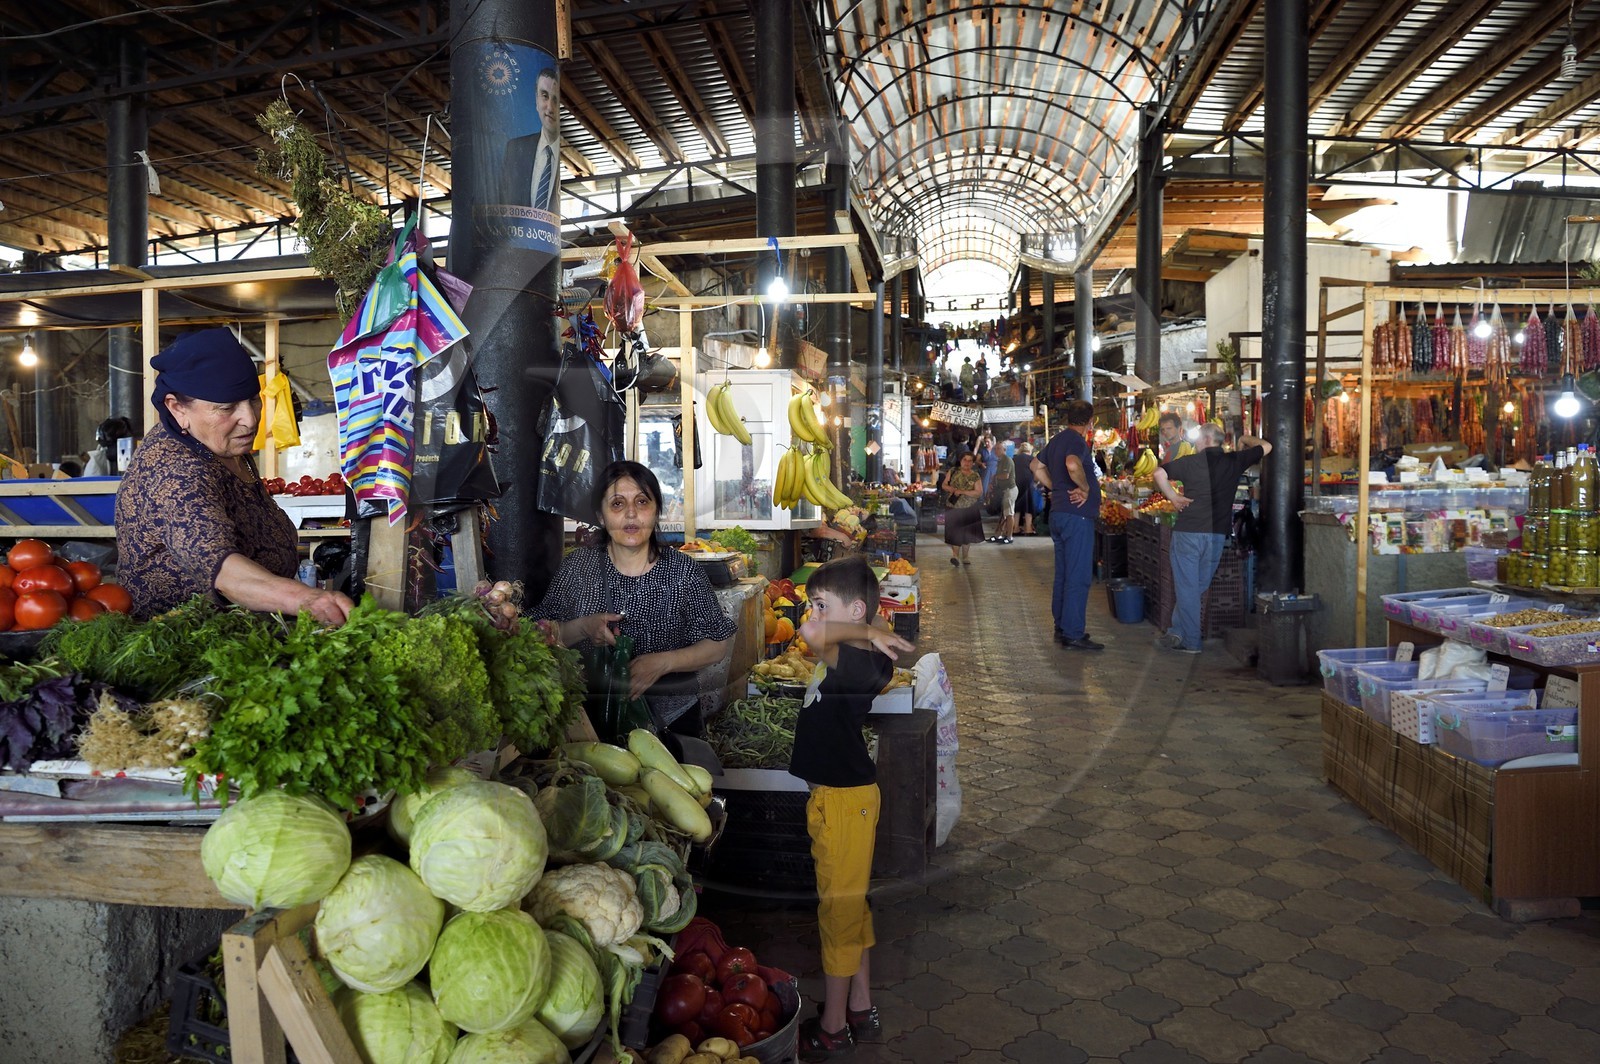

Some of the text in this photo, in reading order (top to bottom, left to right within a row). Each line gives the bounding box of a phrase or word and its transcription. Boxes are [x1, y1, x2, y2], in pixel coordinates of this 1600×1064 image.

[933, 400, 949, 410] DVD
[951, 405, 963, 413] CD
[965, 409, 979, 418] MP3
[422, 411, 486, 445] IOR
